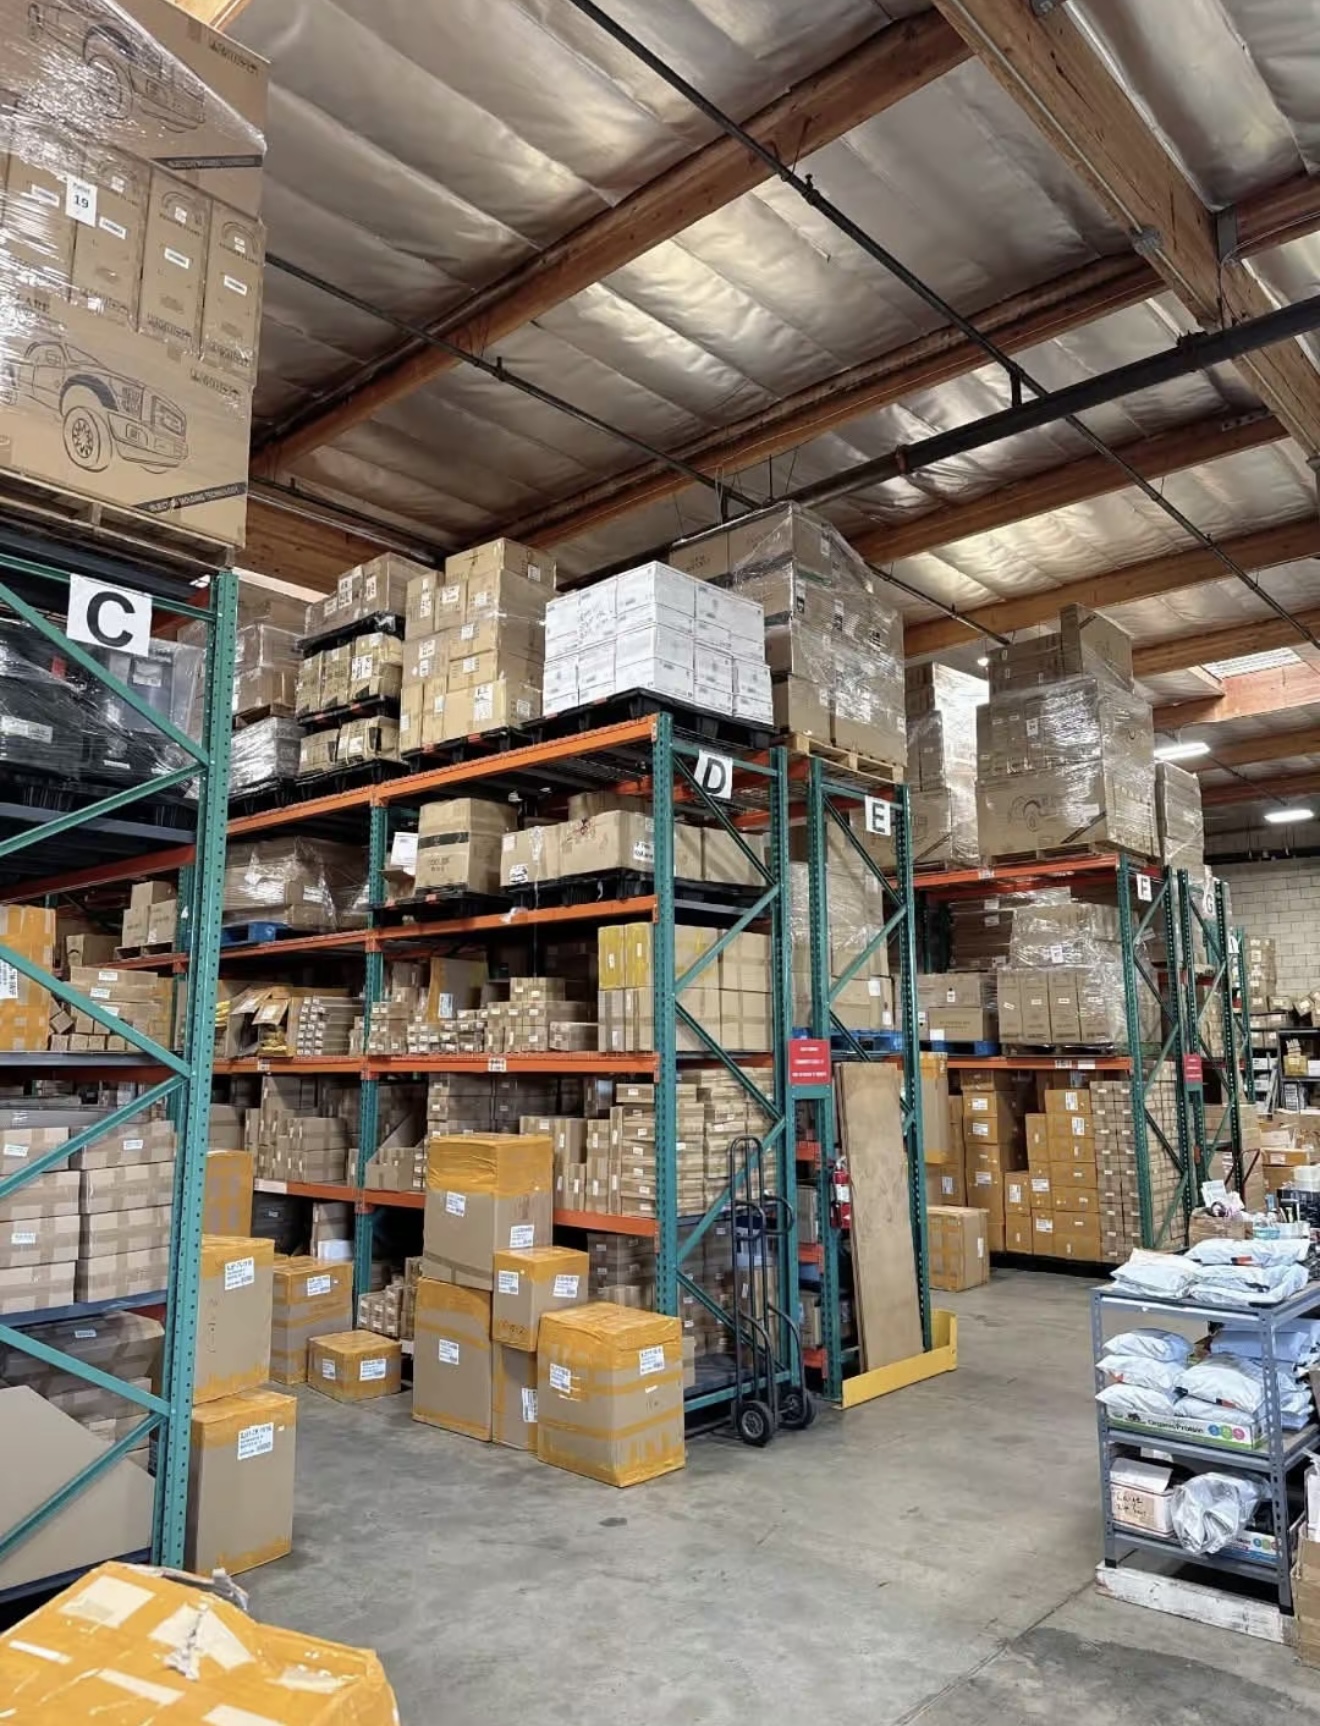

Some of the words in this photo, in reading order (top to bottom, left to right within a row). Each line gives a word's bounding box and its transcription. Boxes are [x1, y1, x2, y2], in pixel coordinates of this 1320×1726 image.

[74, 195, 89, 208] 19
[87, 591, 135, 647] C
[702, 757, 726, 795] D
[872, 803, 885, 833] E
[1140, 877, 1148, 896] F
